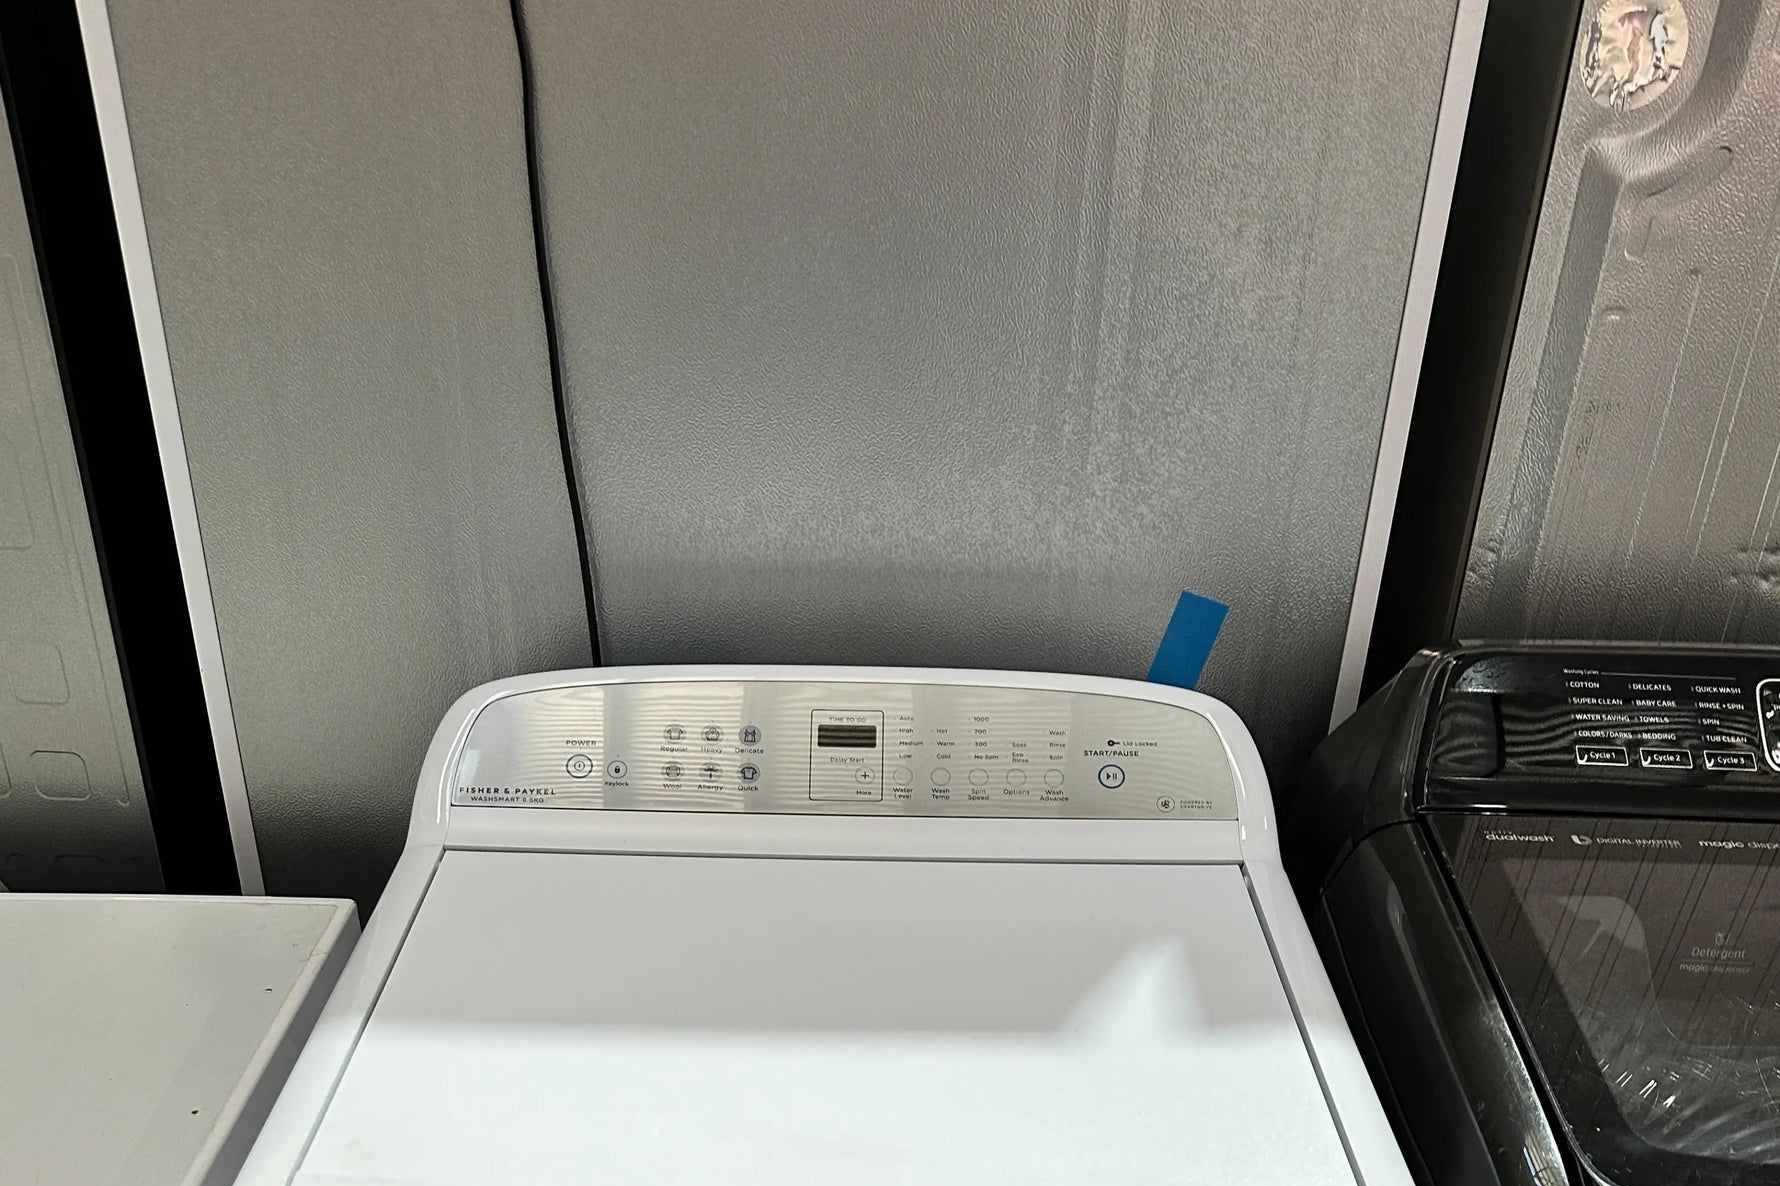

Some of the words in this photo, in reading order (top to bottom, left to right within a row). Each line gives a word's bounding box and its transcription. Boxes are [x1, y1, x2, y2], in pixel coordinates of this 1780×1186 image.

[1569, 681, 1600, 689] COTTON
[1632, 683, 1672, 692] DELICATES
[1695, 685, 1718, 694] QUICK
[1719, 687, 1741, 695] WASH
[1572, 697, 1597, 705] SUPER
[1598, 698, 1623, 706] CLEAN
[1636, 699, 1655, 707] BABY
[1656, 700, 1677, 708] CARE
[1698, 702, 1720, 710] RINSE
[1727, 703, 1744, 711] SPIN
[1575, 713, 1601, 721] WATER
[1602, 714, 1630, 722] SAVING
[1639, 715, 1670, 724] TOWELS
[1702, 718, 1720, 726] SPIN
[899, 727, 914, 735] High
[1642, 732, 1677, 741] BEDDING
[1706, 735, 1721, 743] TUB
[1722, 735, 1748, 743] CLEAN
[566, 739, 597, 747] POWER
[1589, 751, 1611, 760] Cycle
[1653, 753, 1674, 762] Cycle
[1717, 756, 1738, 765] Cycle
[604, 780, 629, 788] Keylock
[459, 786, 500, 794] FISHER
[515, 788, 557, 796] PAYKEL
[1003, 788, 1030, 796] Options
[1486, 833, 1555, 843] dualwash
[1691, 947, 1746, 959] Detergent
